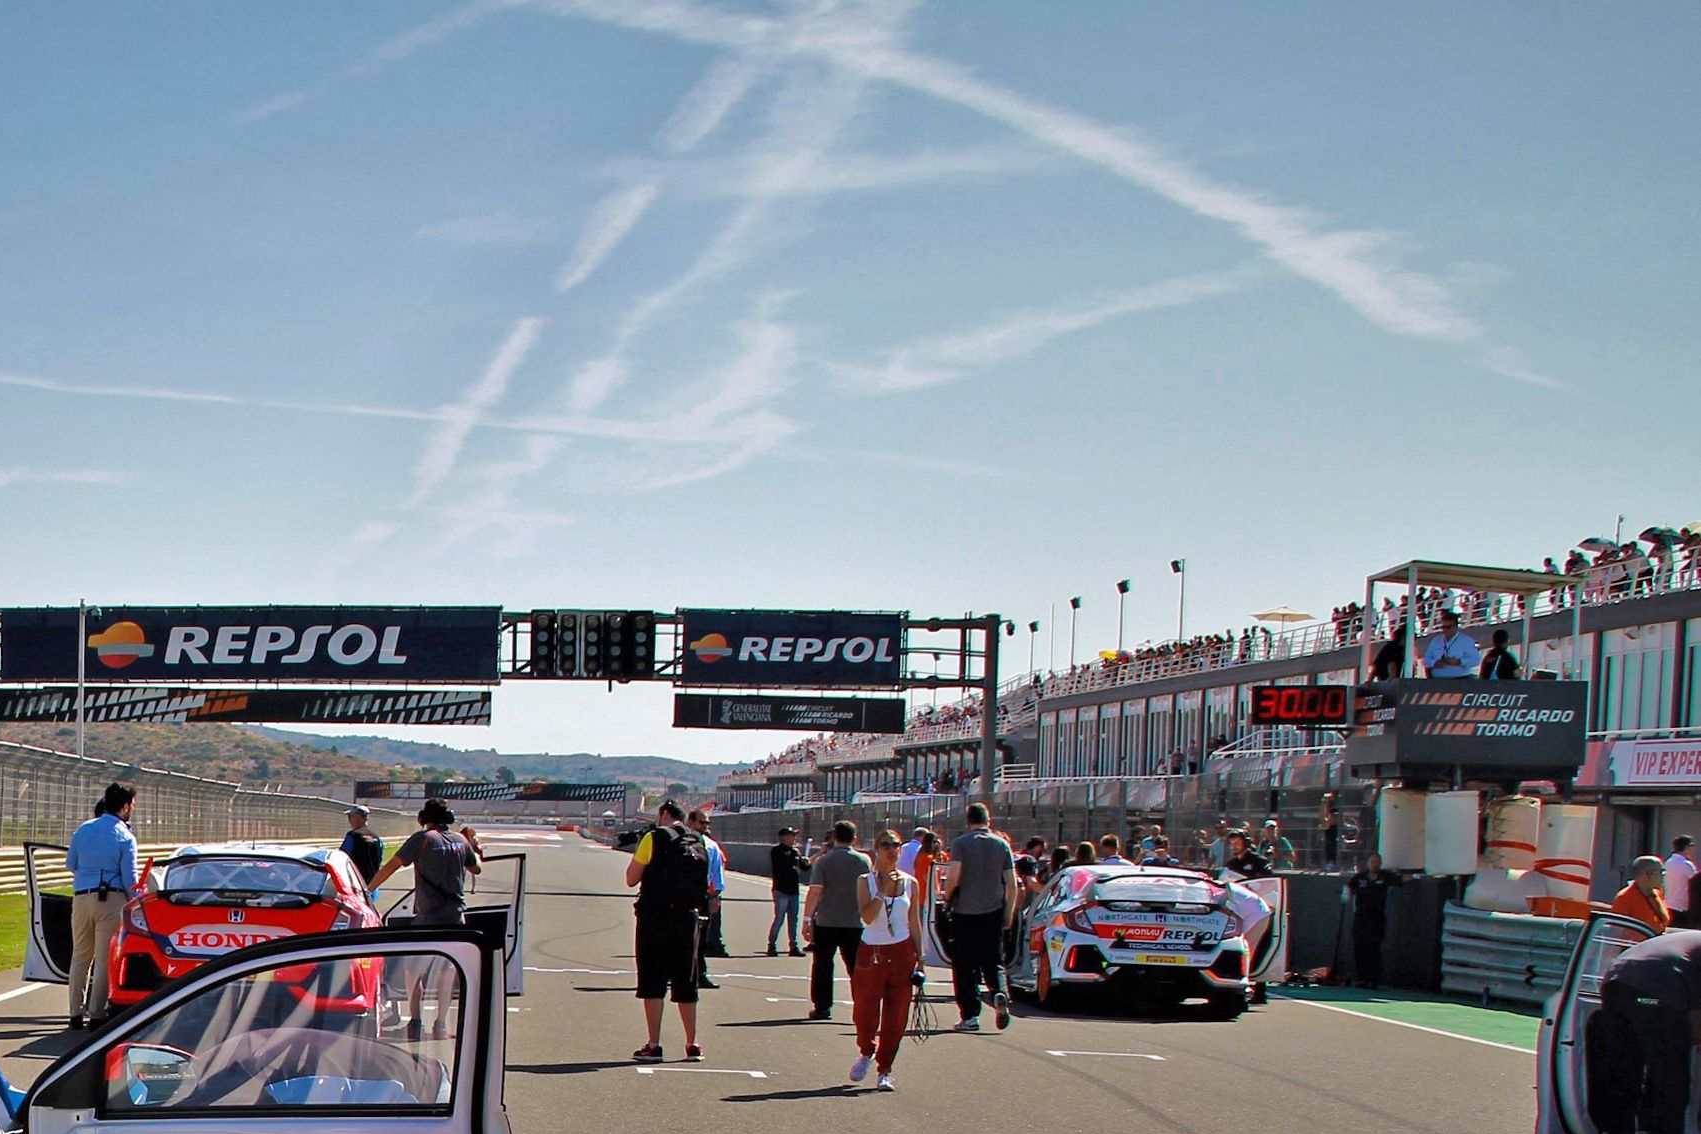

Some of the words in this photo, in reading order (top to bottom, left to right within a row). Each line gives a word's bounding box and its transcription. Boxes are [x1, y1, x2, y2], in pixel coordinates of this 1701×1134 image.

[164, 624, 408, 665] REPSOL
[738, 636, 894, 663] REPSOL
[1461, 692, 1529, 708] CIRCUIT
[812, 717, 839, 726] TORMO
[821, 711, 854, 719] RICARDO
[1496, 708, 1575, 723] RICARDO
[1475, 722, 1538, 737] TORMO
[1635, 751, 1658, 776] VIP
[176, 932, 293, 949] HOND
[1163, 930, 1221, 941] REPSOL
[1167, 943, 1194, 951] SCHOOL
